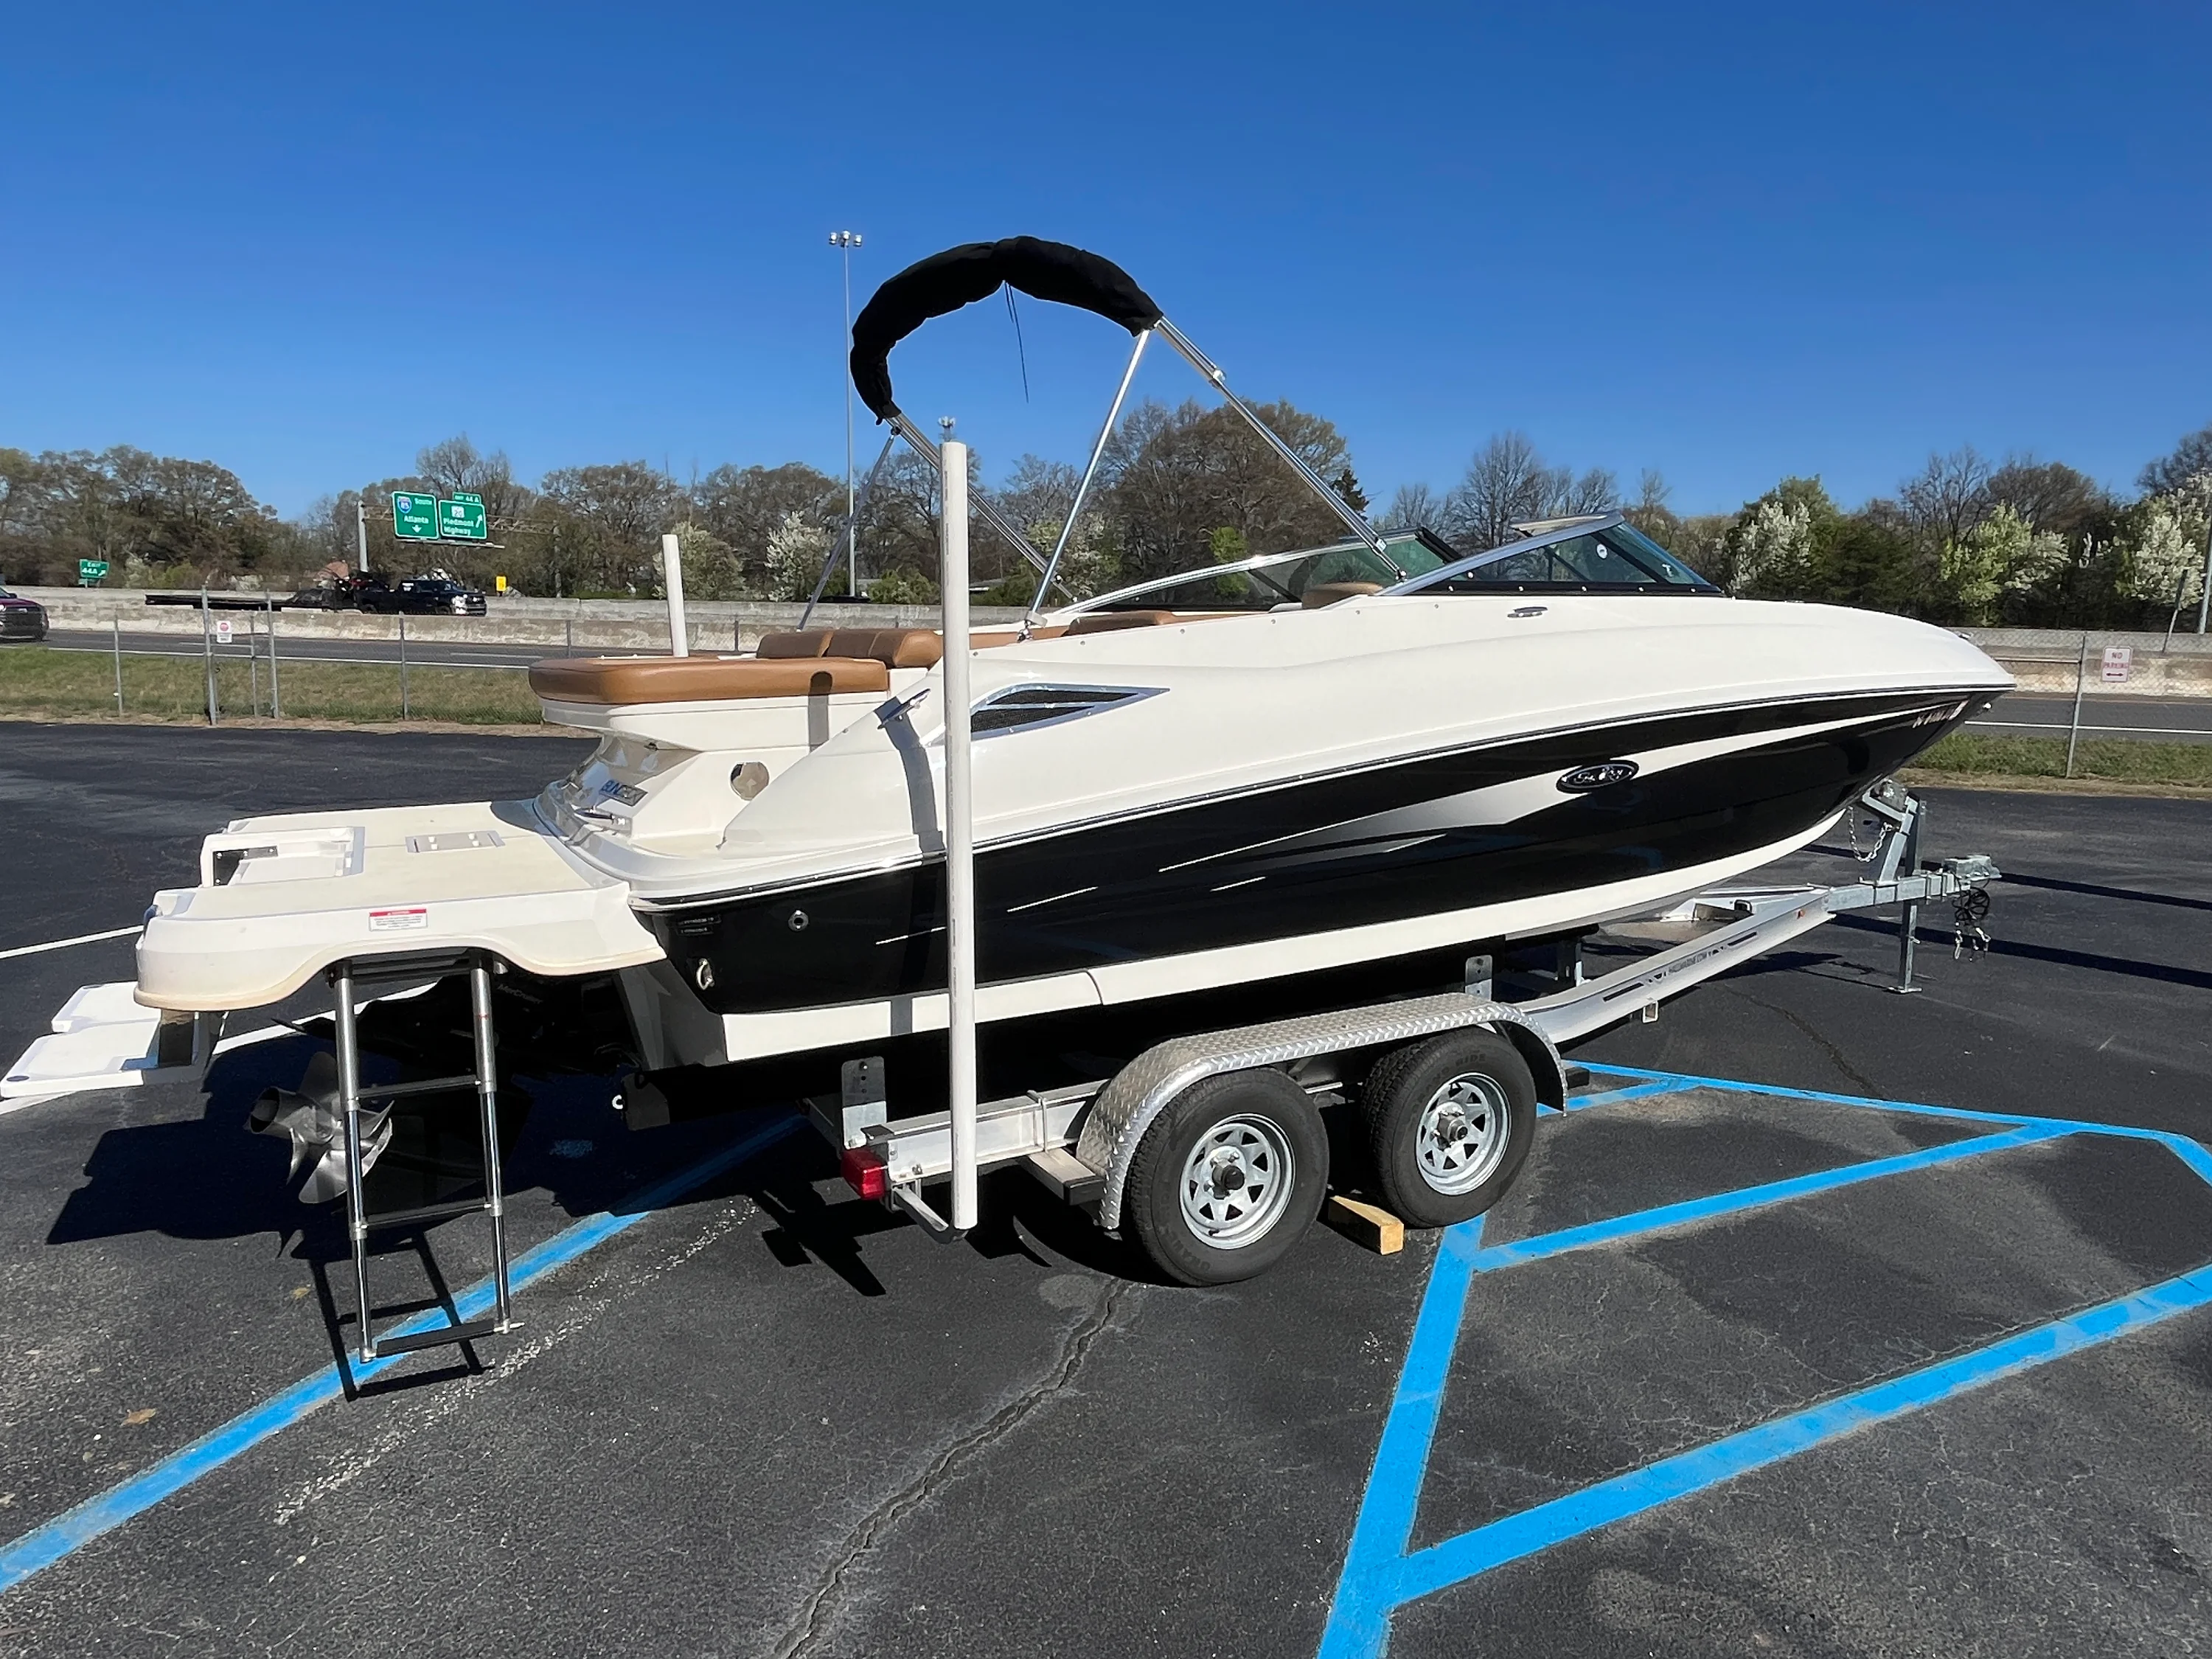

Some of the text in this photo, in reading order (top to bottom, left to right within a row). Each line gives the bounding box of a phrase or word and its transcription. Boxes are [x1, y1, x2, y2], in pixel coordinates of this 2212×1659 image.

[403, 515, 429, 524] Atlanta
[443, 517, 474, 527] Piedmont
[443, 526, 471, 536] Highway
